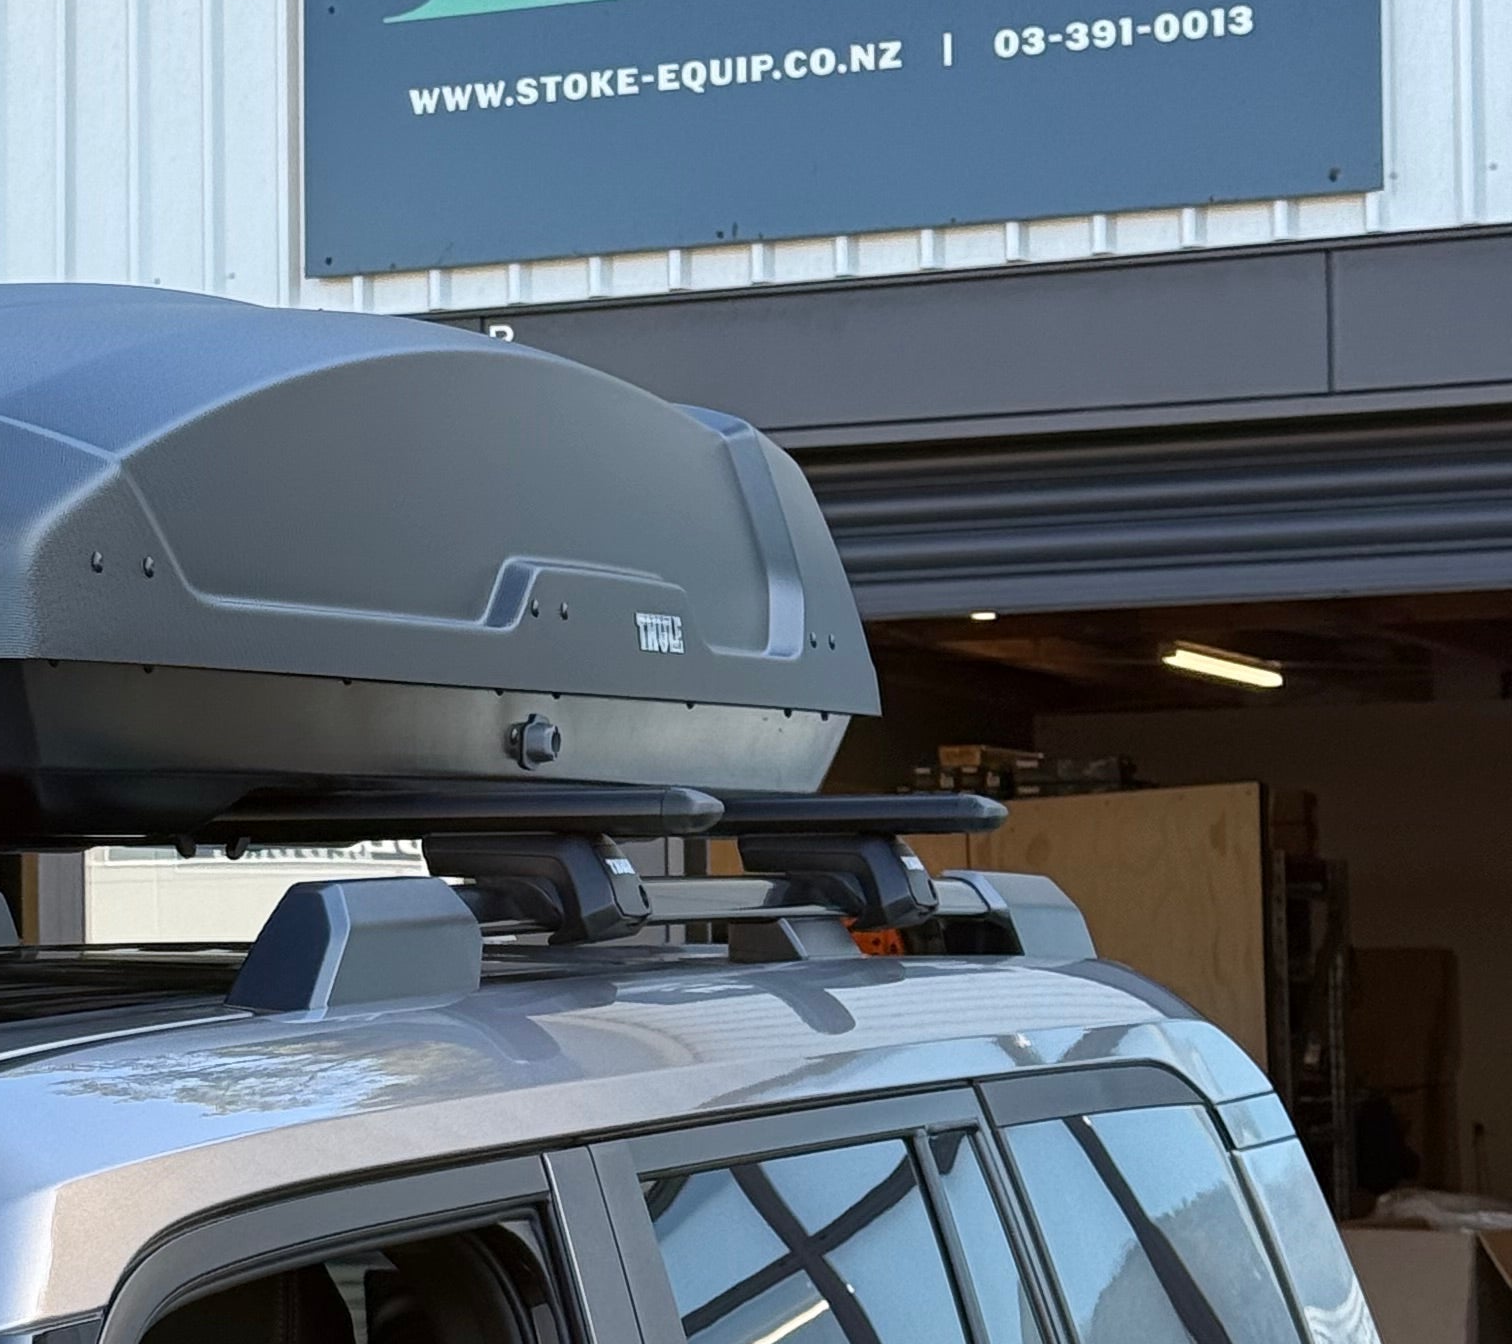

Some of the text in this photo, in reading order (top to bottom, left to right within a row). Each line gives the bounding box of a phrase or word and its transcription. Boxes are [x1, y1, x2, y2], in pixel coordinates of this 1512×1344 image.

[408, 39, 903, 116] WWW.STOKE-EQUIP.CO.NZ
[993, 4, 1255, 59] 03-391-0013
[635, 612, 685, 654] THULE
